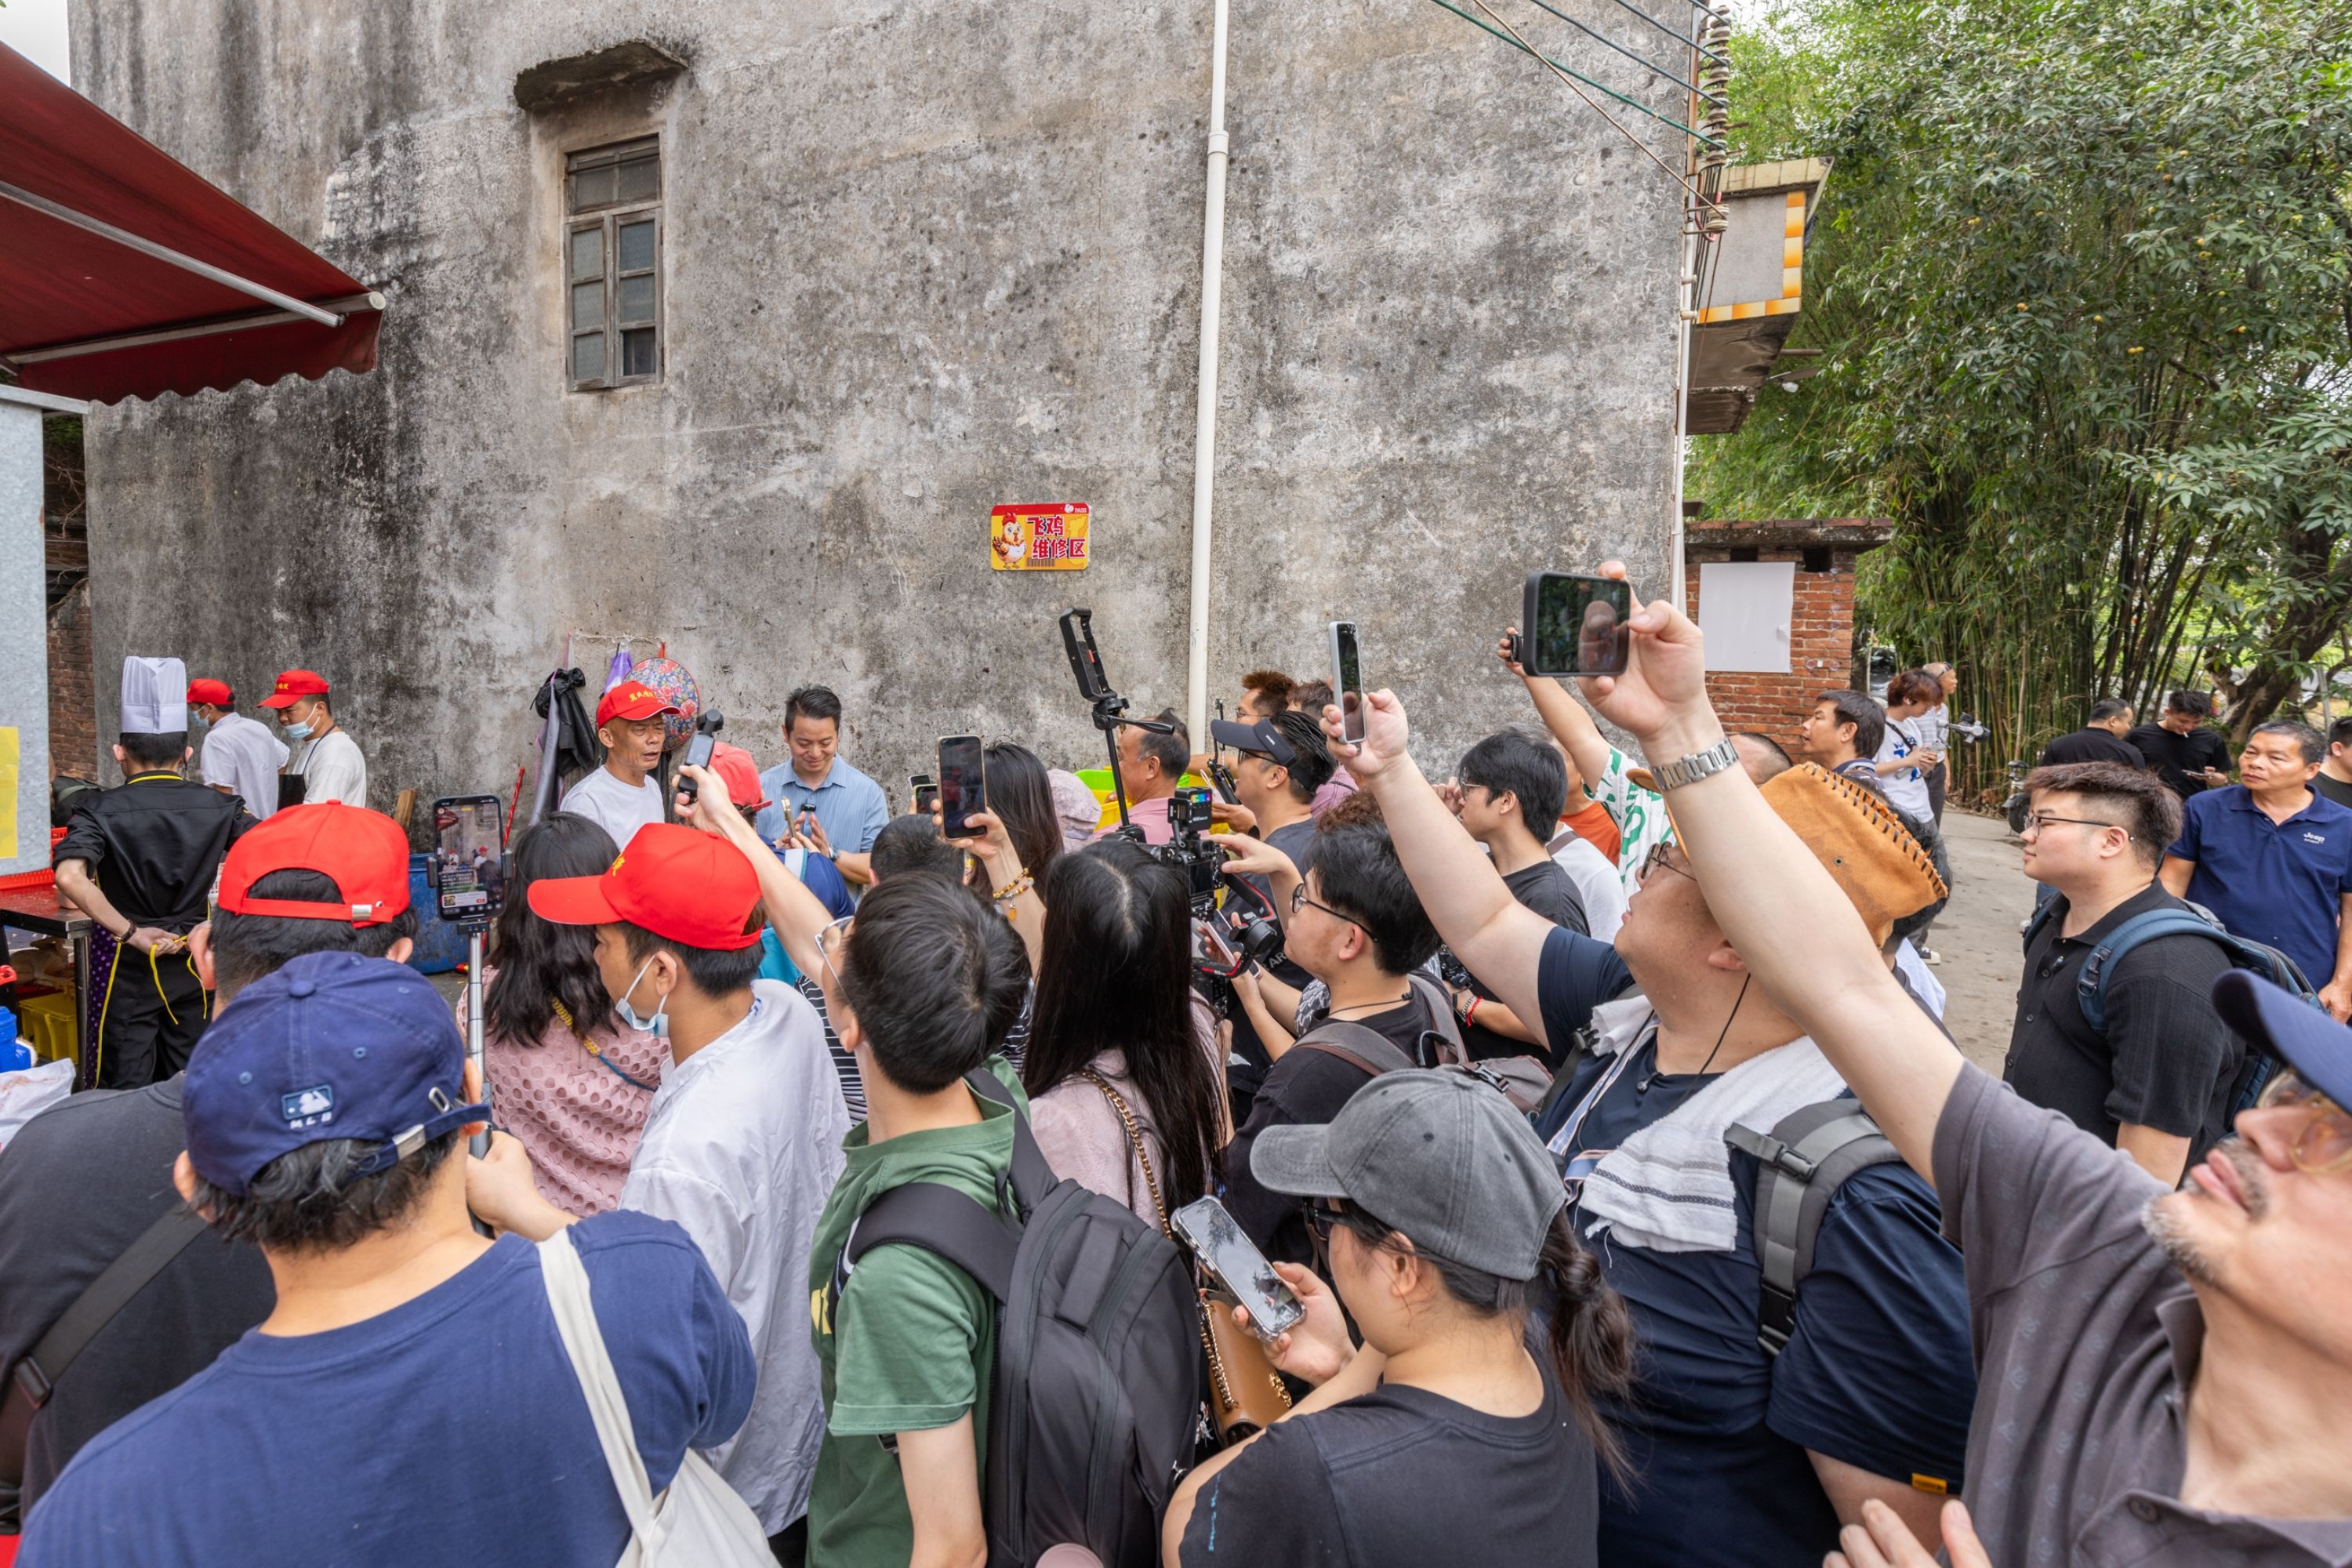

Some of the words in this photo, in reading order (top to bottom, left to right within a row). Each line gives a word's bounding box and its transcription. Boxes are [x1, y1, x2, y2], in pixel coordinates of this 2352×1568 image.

[1027, 515, 1064, 535] 飞鸡
[1032, 538, 1086, 559] 维修区
[2303, 832, 2325, 842] Jeep
[290, 1111, 332, 1129] MLB
